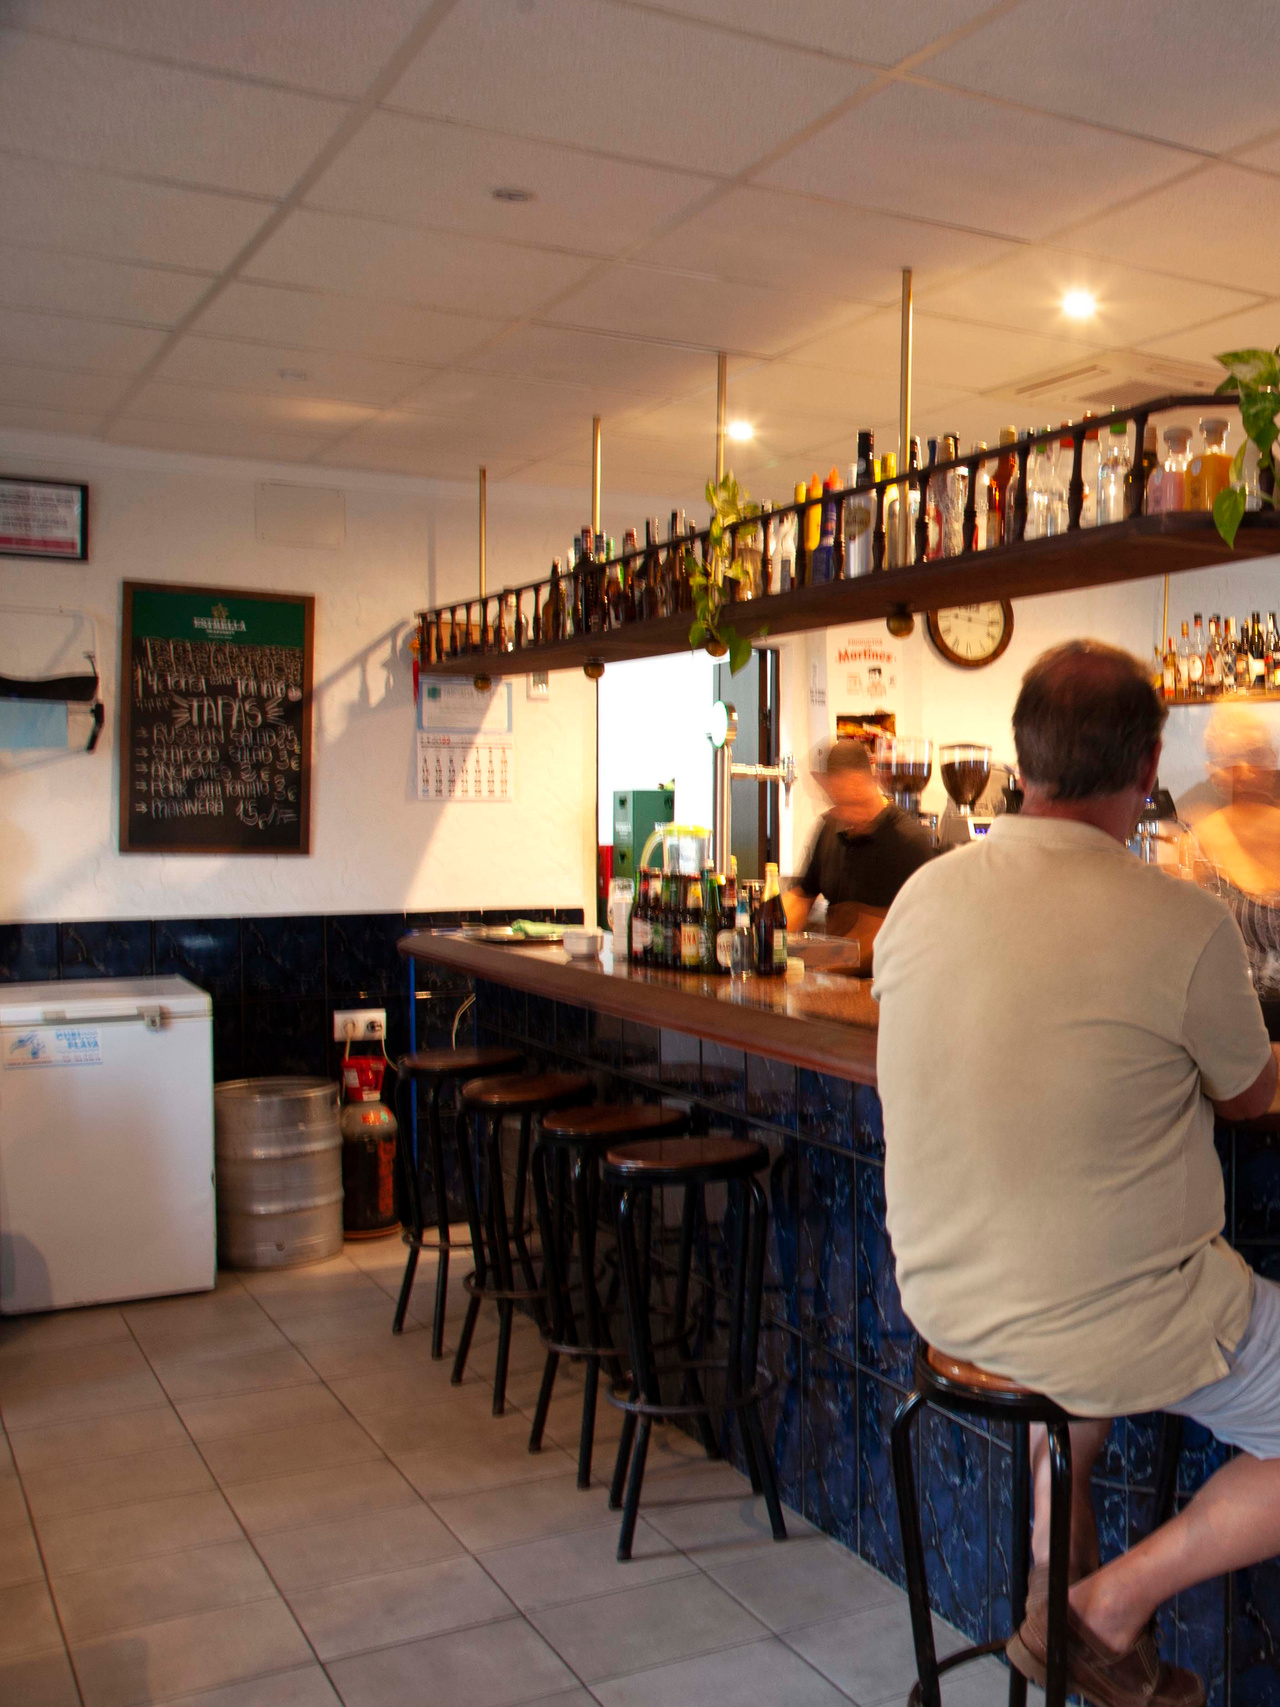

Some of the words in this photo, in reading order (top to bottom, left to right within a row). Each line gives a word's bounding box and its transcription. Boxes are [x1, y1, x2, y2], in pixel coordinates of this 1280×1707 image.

[187, 695, 262, 729] TAPAS
[153, 723, 224, 744] RUSSIAN
[230, 726, 276, 746] SALAD
[153, 745, 219, 764] SEAFOOD
[229, 745, 273, 764] SALAD
[152, 762, 232, 781] ANCHOVIES
[152, 779, 187, 798] PORK
[152, 799, 224, 818] MARINERA
